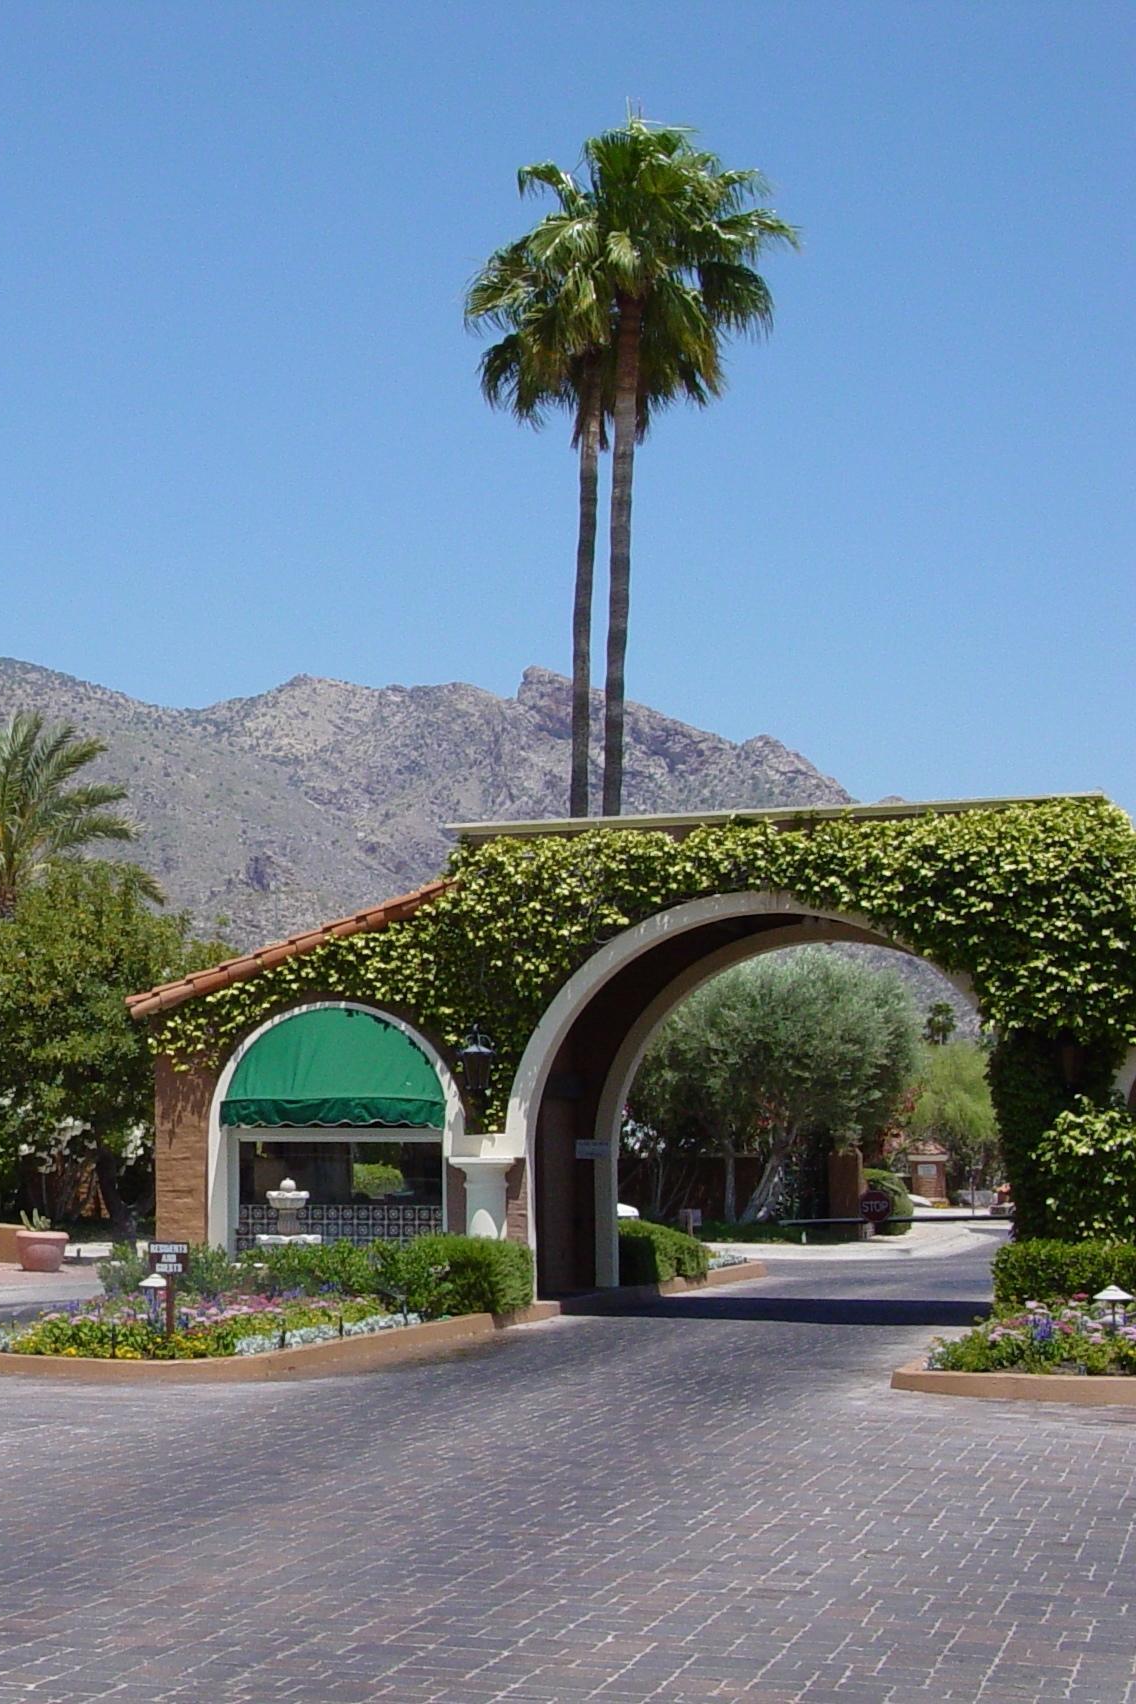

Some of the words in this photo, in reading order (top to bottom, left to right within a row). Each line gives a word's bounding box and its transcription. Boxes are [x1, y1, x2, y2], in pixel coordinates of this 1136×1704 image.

[861, 1200, 889, 1213] STOP
[150, 1244, 188, 1254] RESIDENTS
[161, 1254, 177, 1263] AND
[155, 1263, 183, 1273] GUESTS
